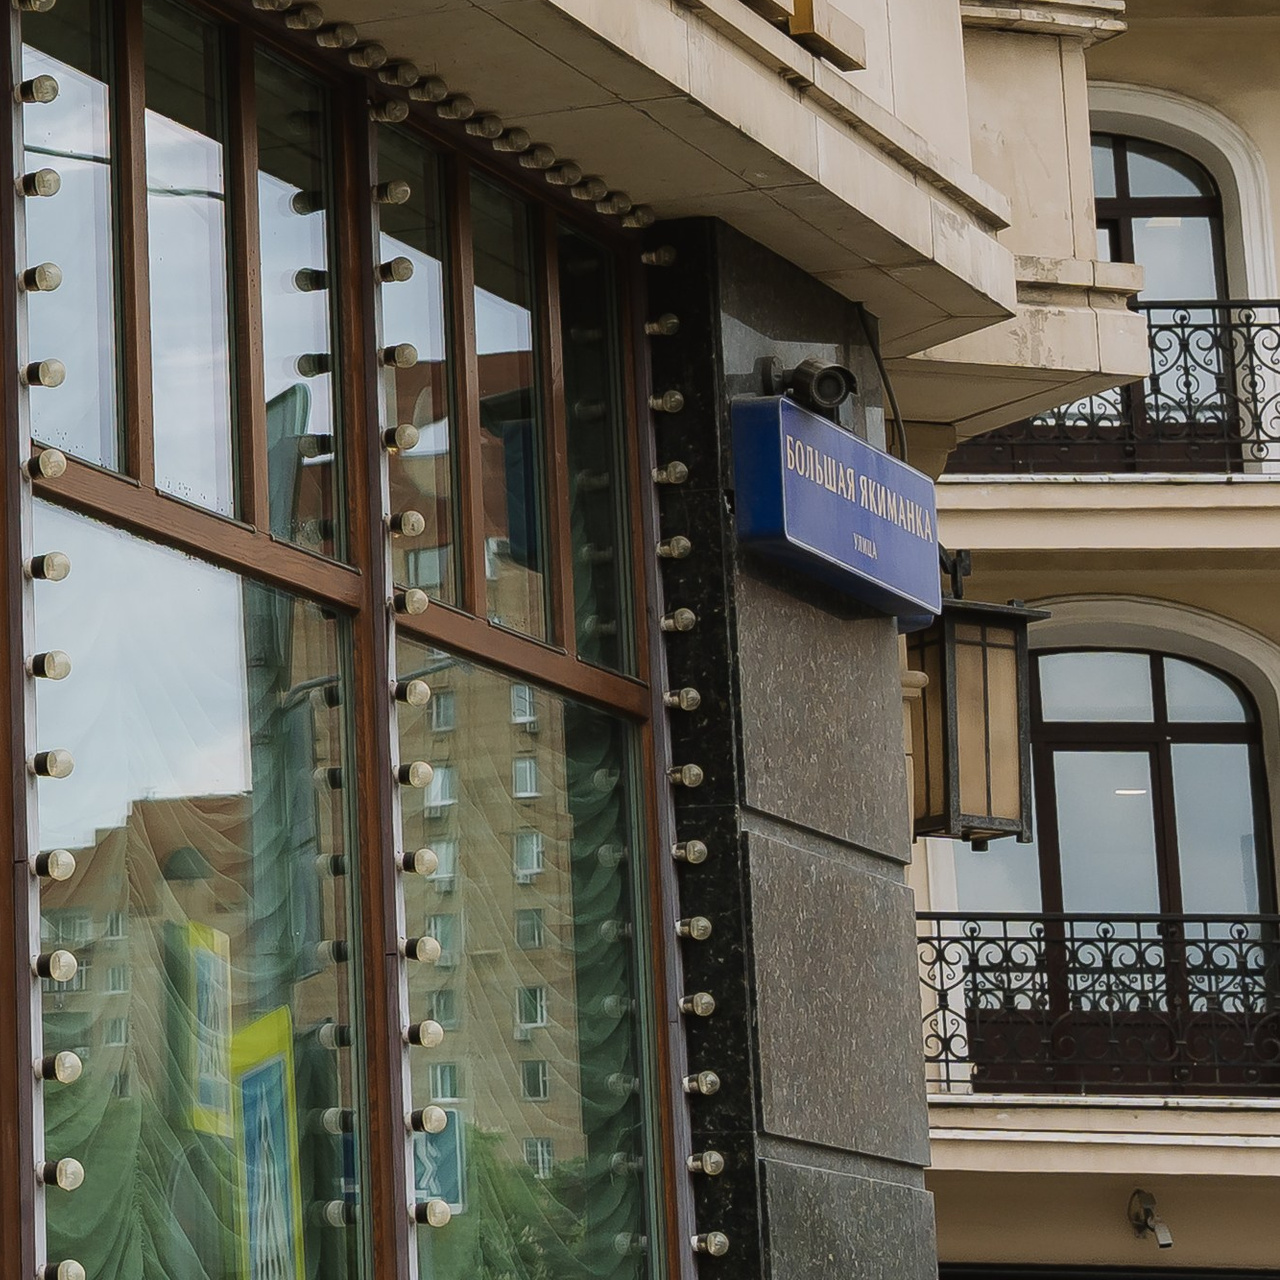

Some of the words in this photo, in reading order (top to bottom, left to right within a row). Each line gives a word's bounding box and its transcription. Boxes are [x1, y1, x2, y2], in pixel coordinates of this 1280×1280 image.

[786, 434, 855, 502] БОЛЬШАЯ
[859, 476, 934, 543] ЯКИМАНКА
[853, 533, 878, 560] УЛИЦА
